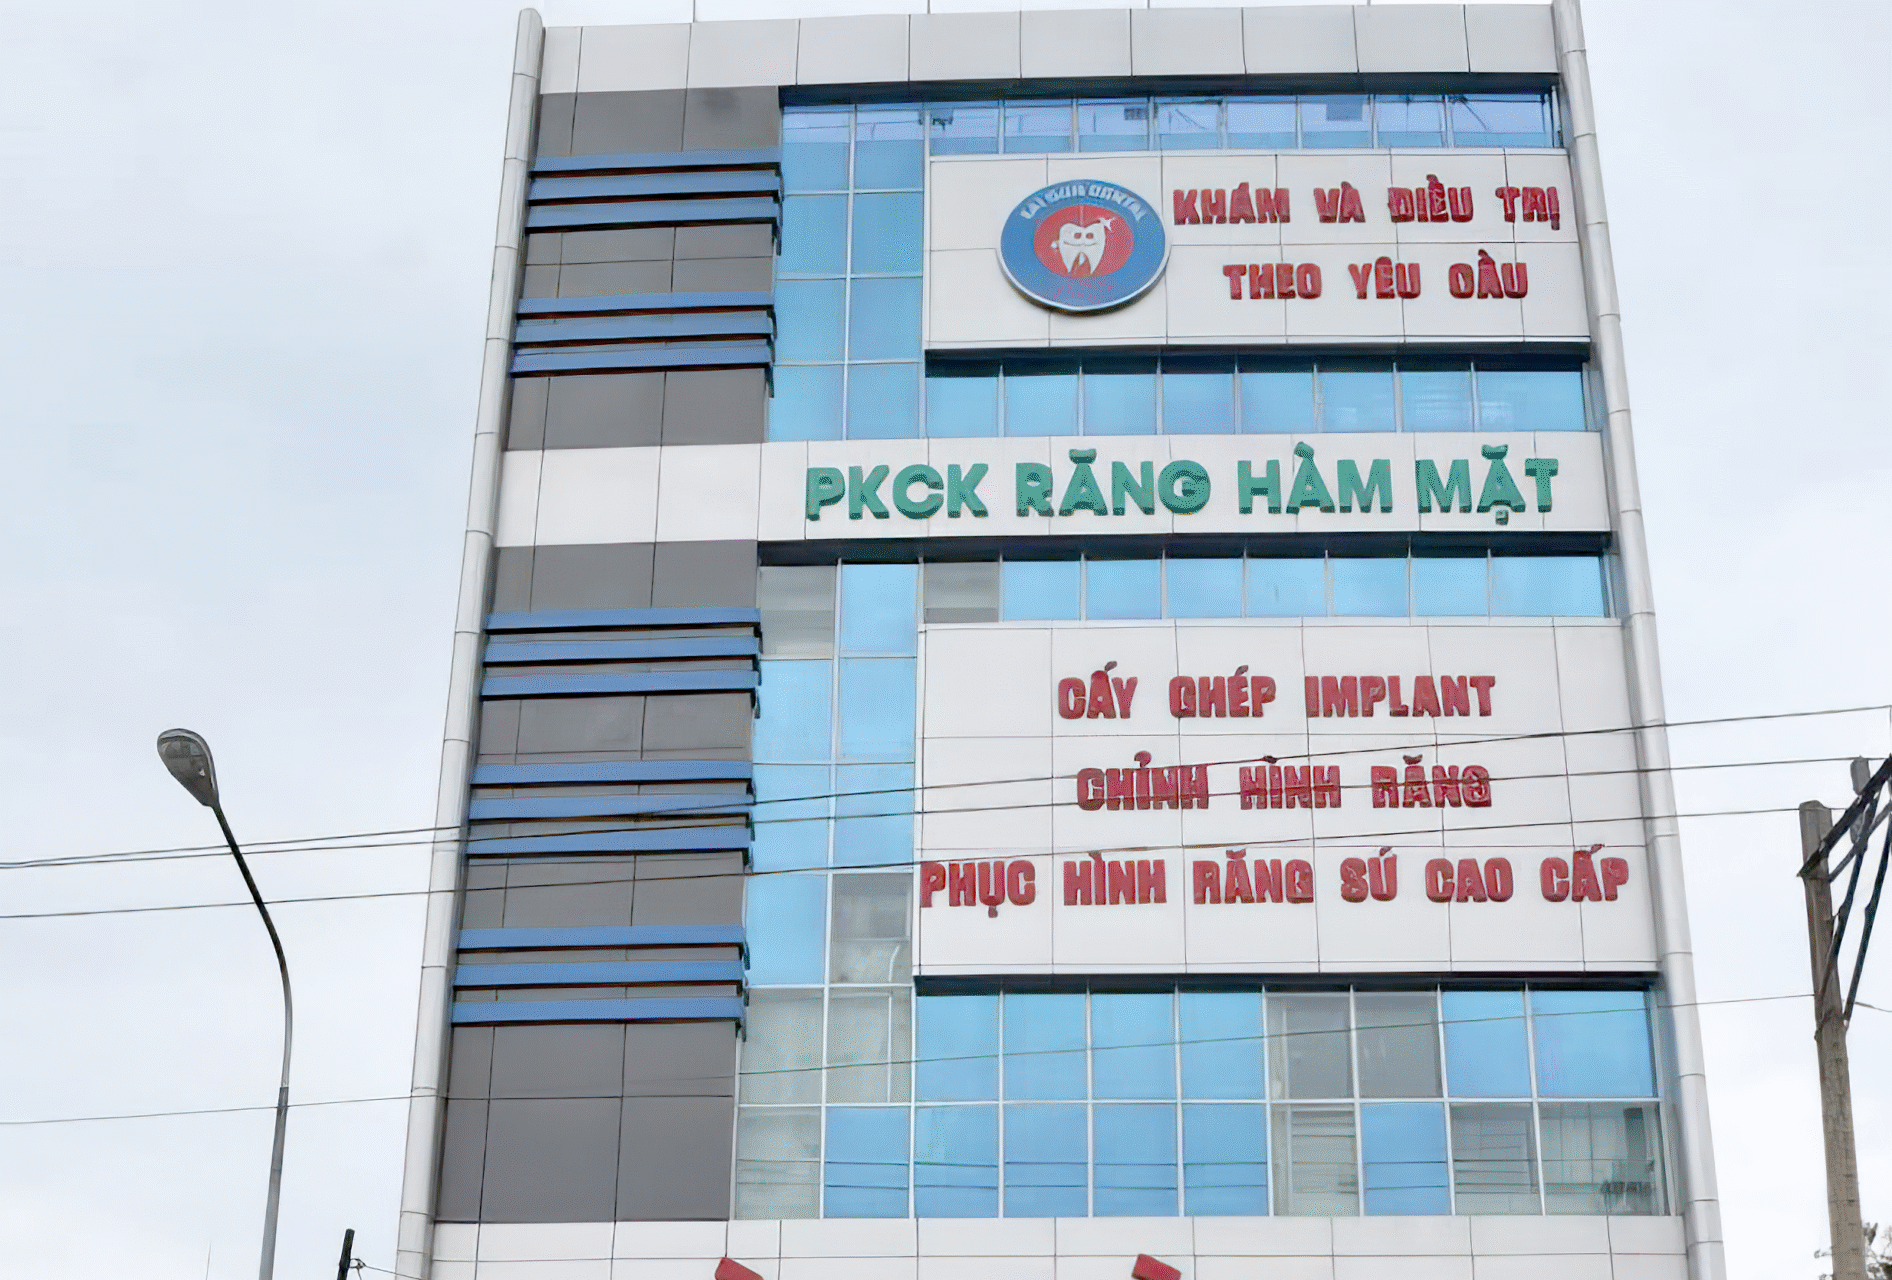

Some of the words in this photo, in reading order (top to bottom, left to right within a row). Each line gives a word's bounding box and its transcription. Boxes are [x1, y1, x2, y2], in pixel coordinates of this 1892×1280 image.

[1172, 181, 1291, 226] KHÁM
[1313, 181, 1366, 223] VÀ
[1495, 186, 1560, 231] TRỊ
[1223, 262, 1322, 300] THEO
[1348, 256, 1421, 300] YÊU
[806, 463, 989, 521] PKCK
[1016, 448, 1212, 517] RĂNG
[1237, 441, 1393, 515] HÀM
[1415, 443, 1559, 526] MẶT
[1058, 660, 1138, 719] CẤY
[1169, 665, 1276, 718] GHÉP
[1304, 675, 1495, 718] IMPLANT
[1077, 750, 1209, 811] CHỈNH
[1370, 754, 1493, 808] RĂNG
[919, 860, 1036, 918] PHỤC
[1063, 850, 1167, 906] HÌNH
[1192, 848, 1314, 904] RĂNG
[1425, 858, 1514, 903] CAO
[1540, 843, 1629, 903] CẤP
